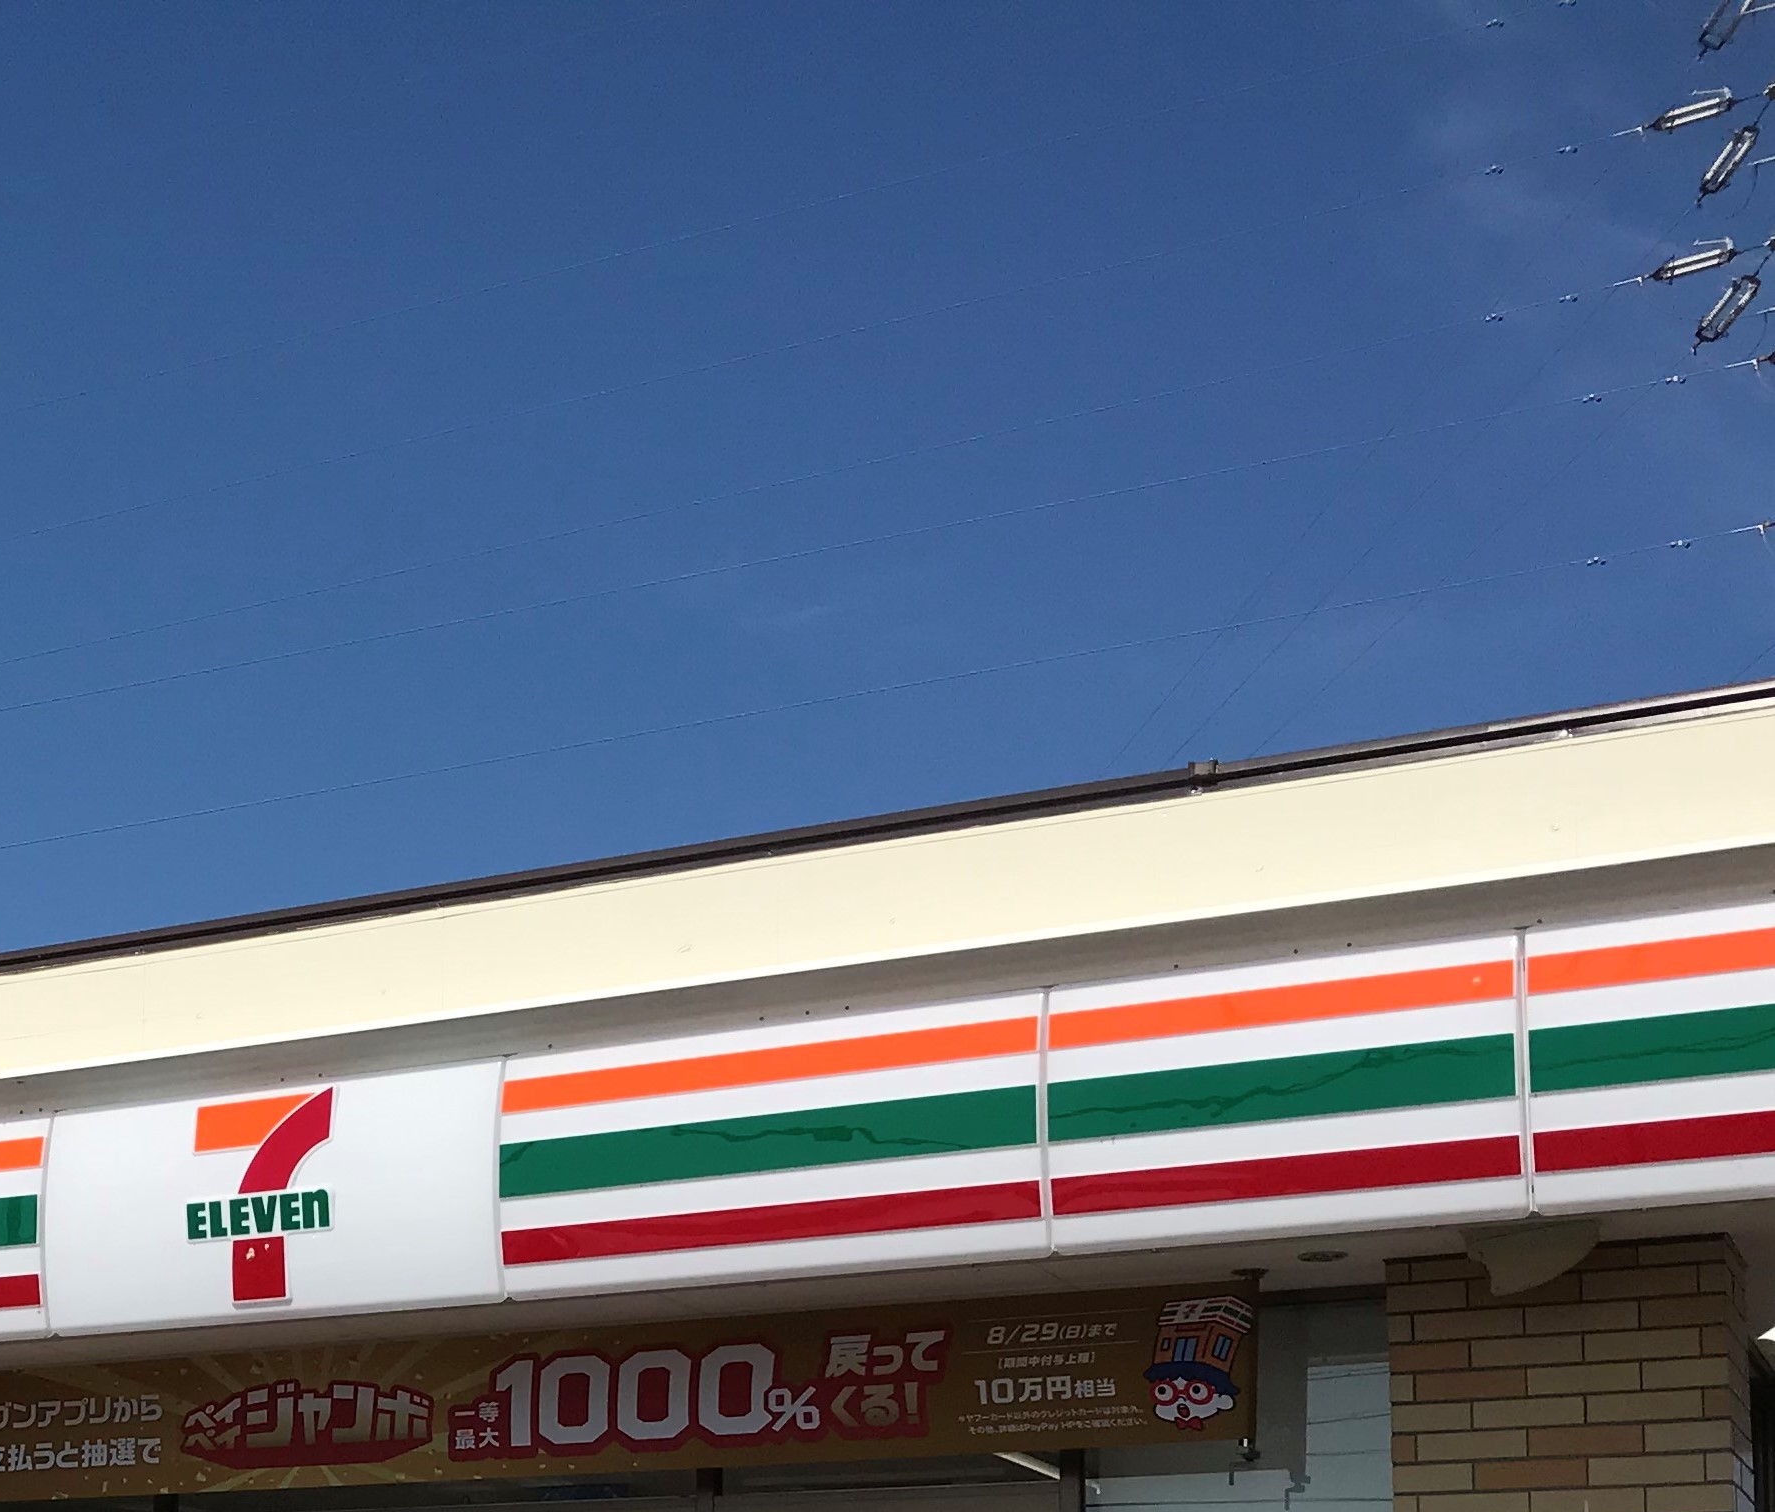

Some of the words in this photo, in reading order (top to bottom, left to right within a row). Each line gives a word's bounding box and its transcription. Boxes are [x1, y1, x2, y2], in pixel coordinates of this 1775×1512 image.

[826, 1330, 946, 1378] 戻って
[975, 1375, 1116, 1405] 10万円相当
